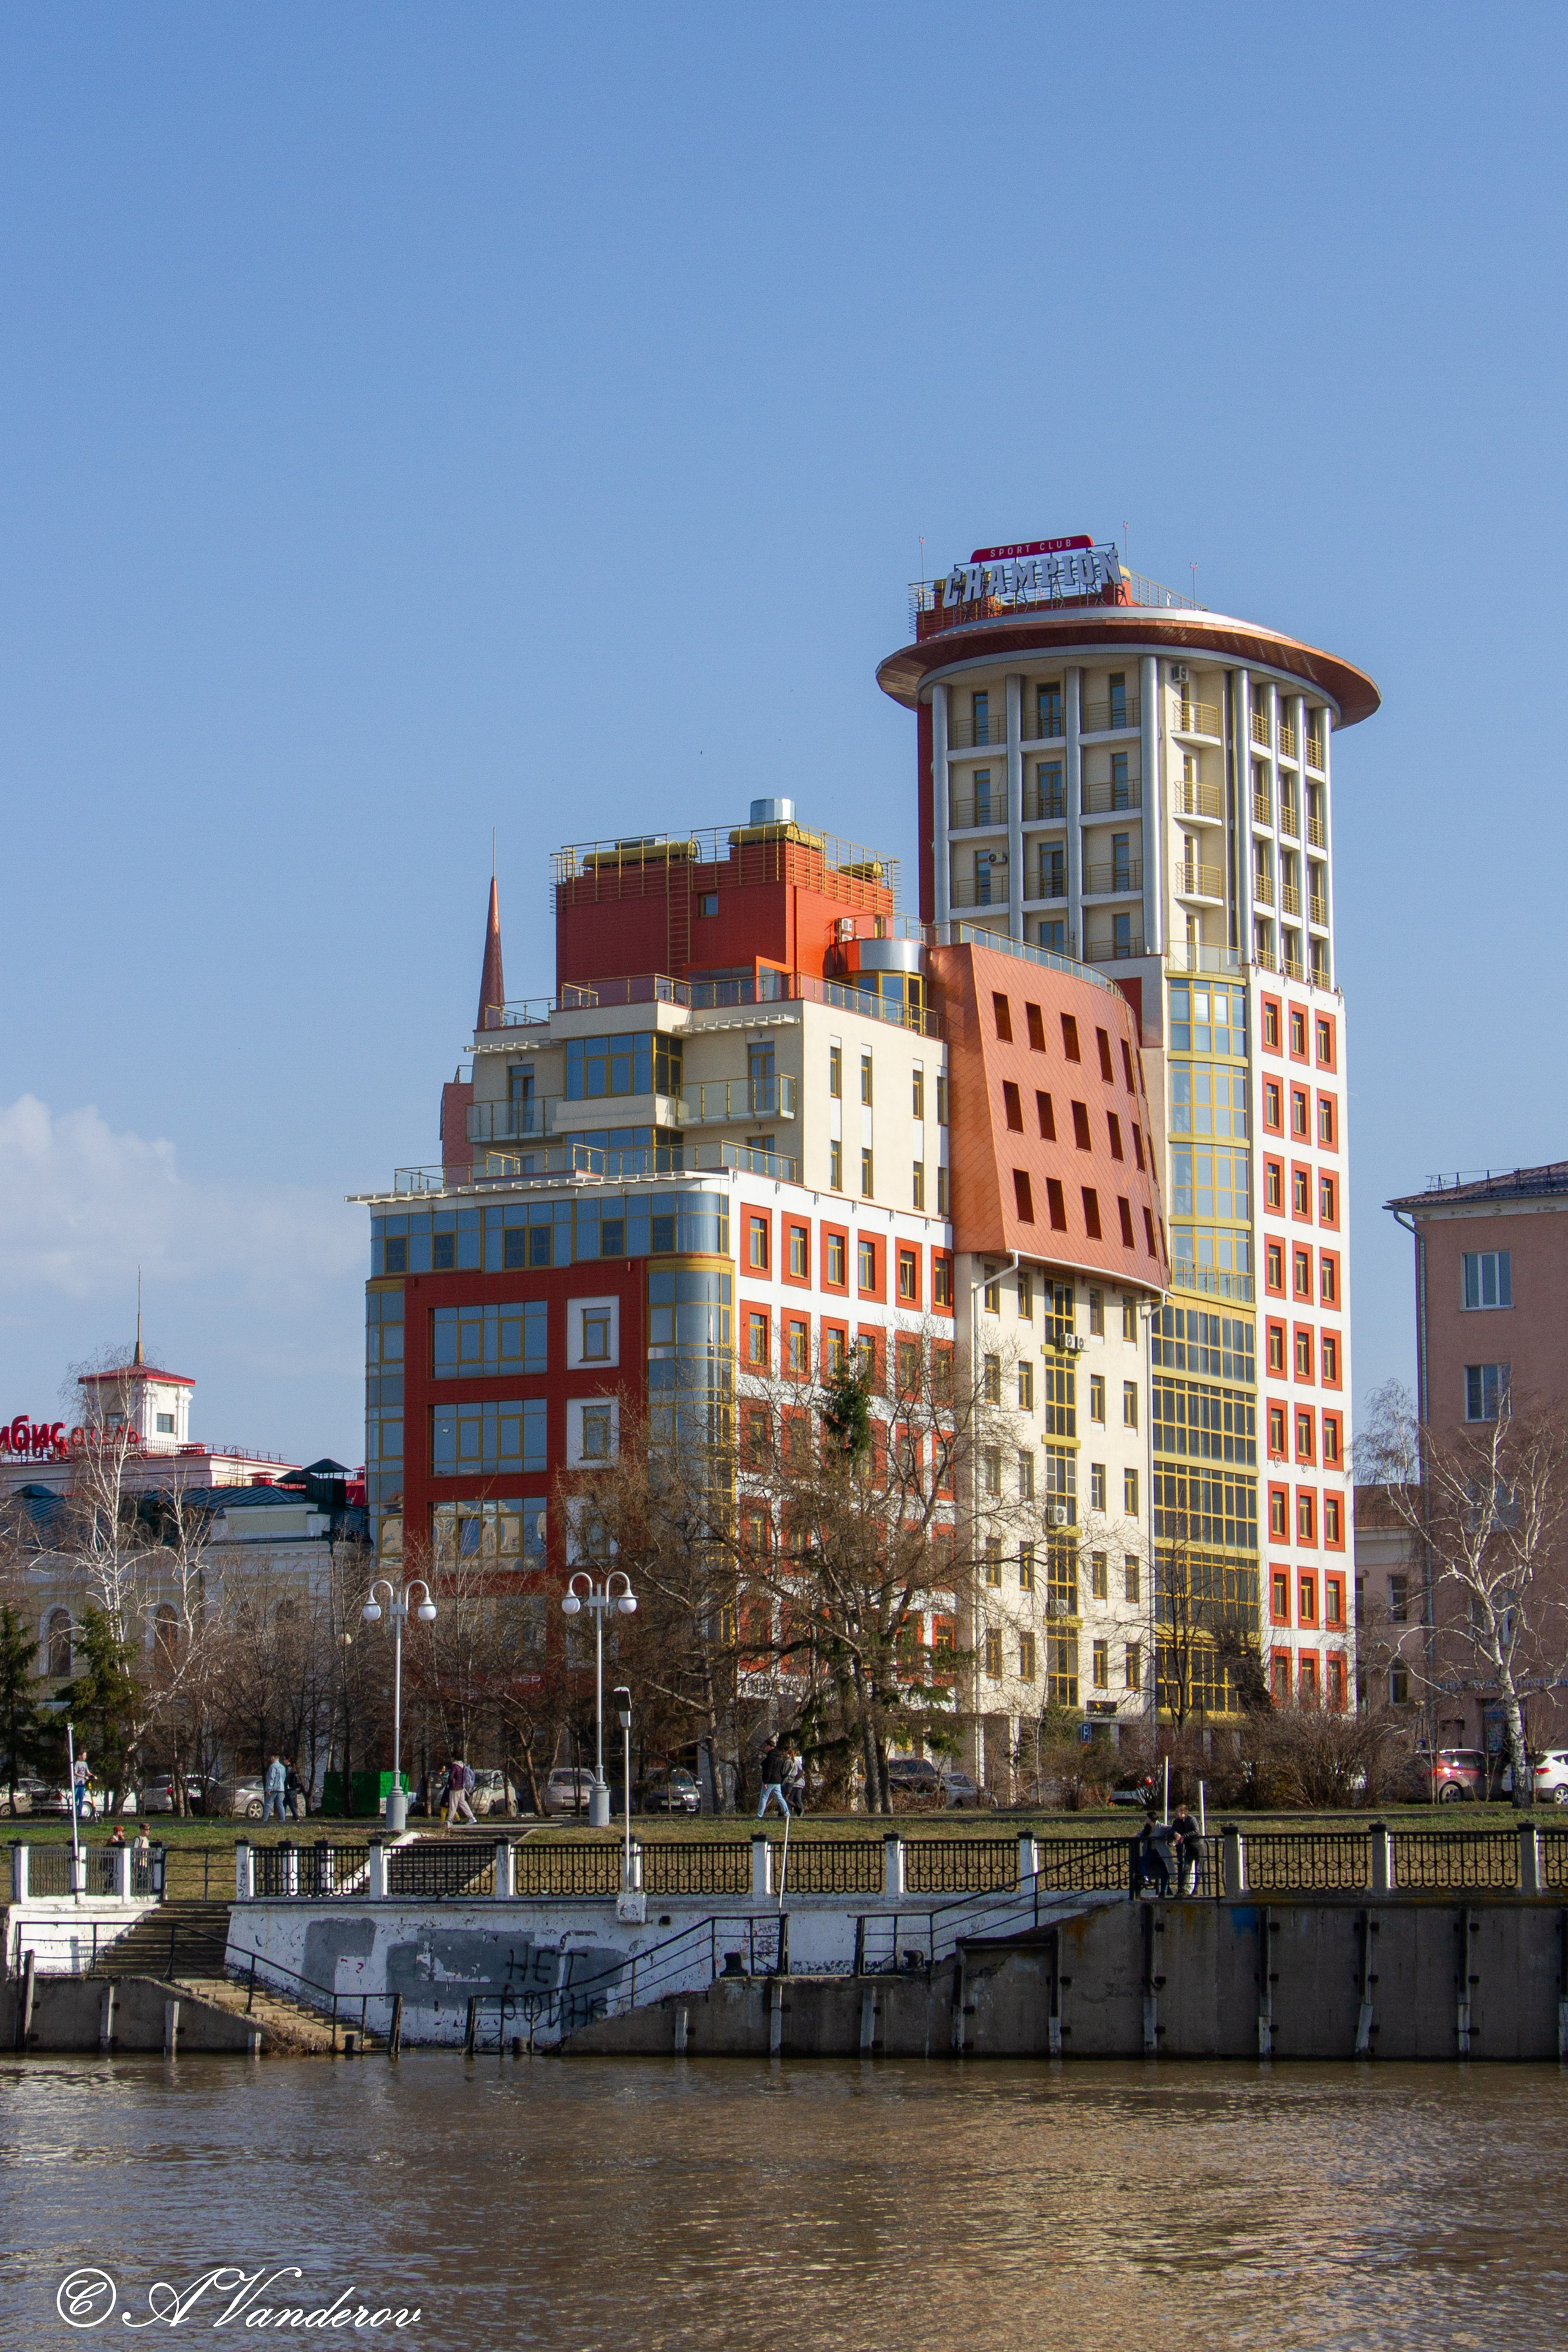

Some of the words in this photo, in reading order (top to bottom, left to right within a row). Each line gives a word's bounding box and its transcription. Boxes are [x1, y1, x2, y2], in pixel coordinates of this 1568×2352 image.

[990, 544, 1030, 558] SPORT
[1039, 538, 1071, 551] CLUB
[942, 549, 1122, 609] CHAMPION
[505, 1942, 588, 1992] НЕТ
